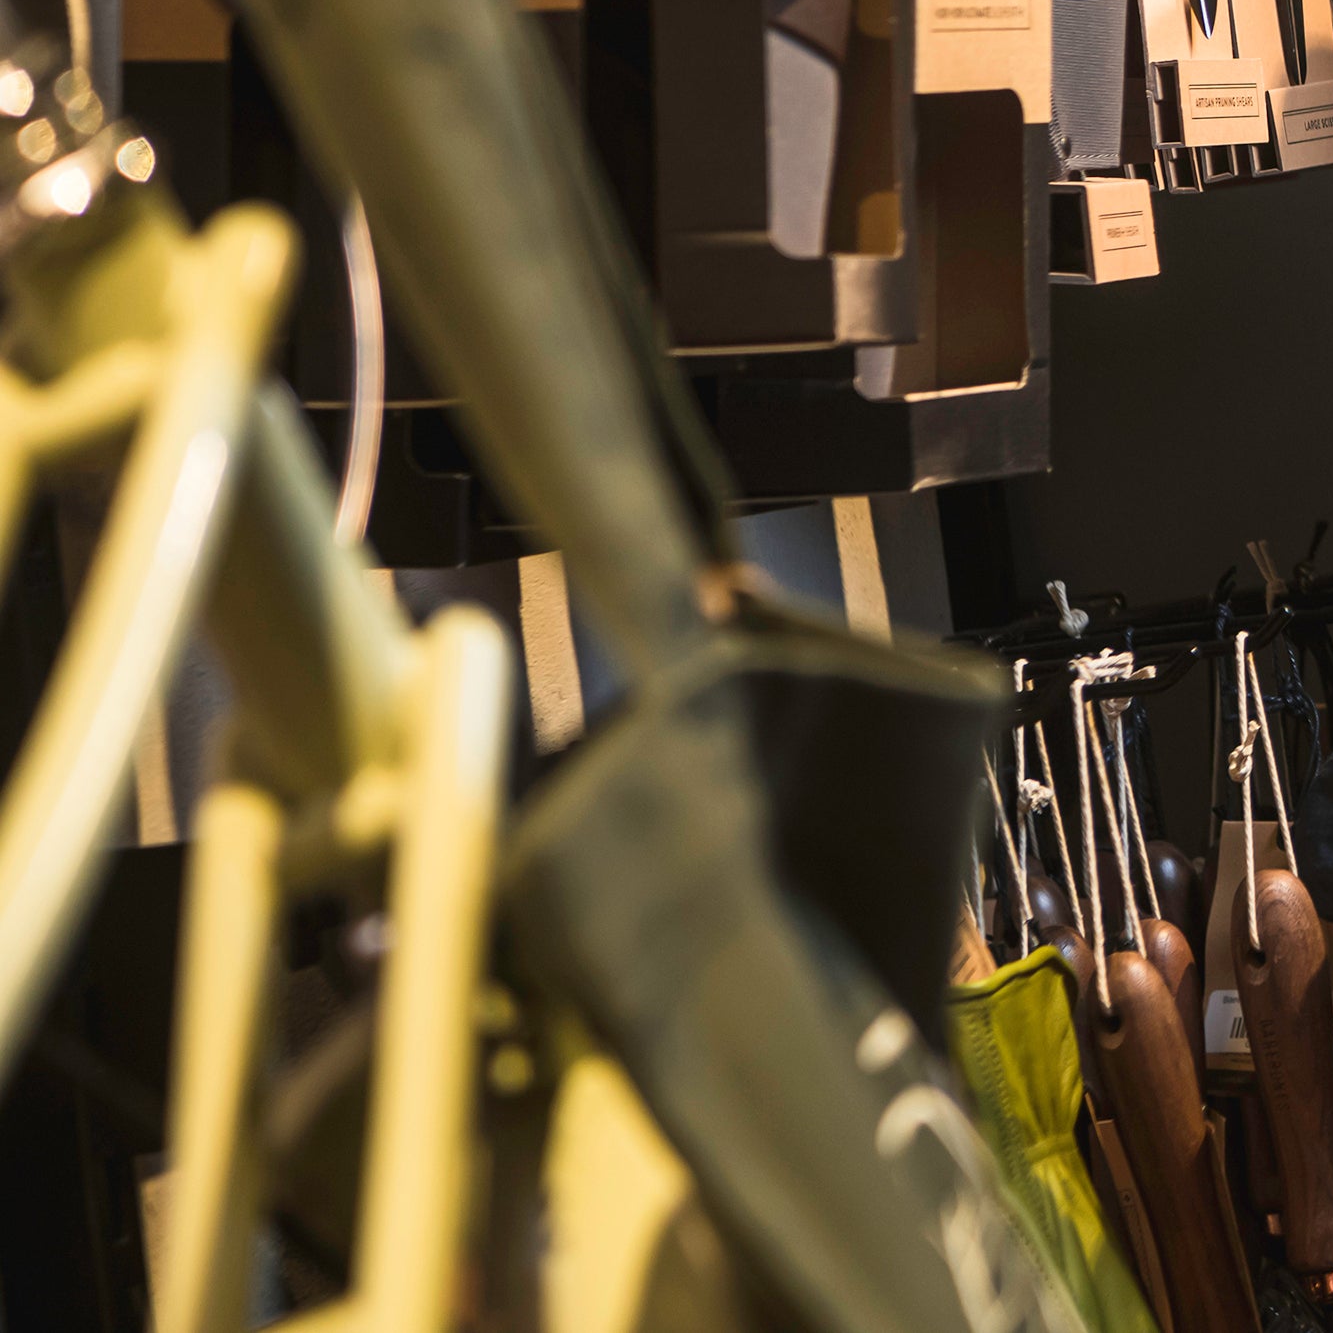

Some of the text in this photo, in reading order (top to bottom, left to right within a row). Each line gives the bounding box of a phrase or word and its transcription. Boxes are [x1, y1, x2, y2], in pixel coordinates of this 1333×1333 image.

[1195, 96, 1253, 107] ARTISAN PRUNING SHEARS
[1304, 119, 1321, 132] LARGE
